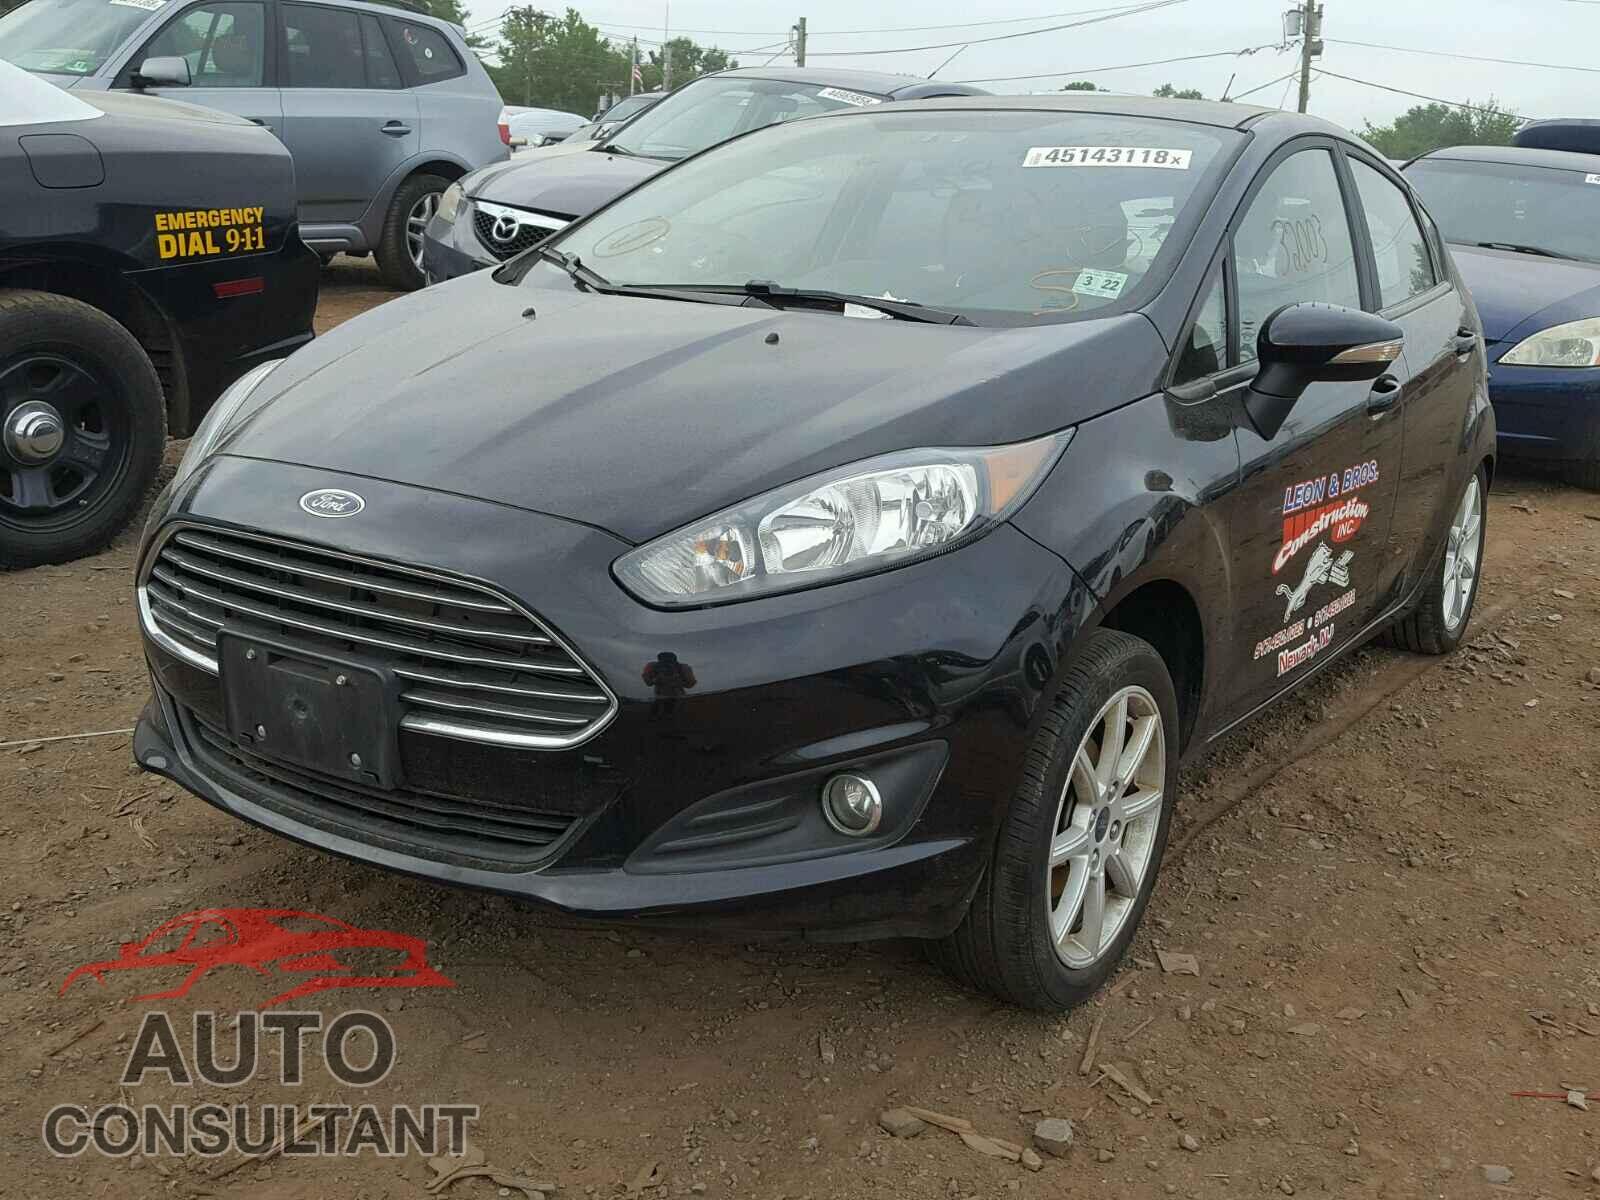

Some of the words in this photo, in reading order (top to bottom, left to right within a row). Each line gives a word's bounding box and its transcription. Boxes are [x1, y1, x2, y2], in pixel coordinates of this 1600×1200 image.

[155, 206, 264, 231] EMERGENCY
[158, 231, 220, 259] DIAL
[1082, 275, 1093, 286] 3
[1101, 279, 1120, 291] 22
[311, 493, 351, 512] Ford
[1283, 476, 1327, 515] LEON
[1328, 473, 1339, 498] &
[1272, 497, 1370, 573] Construction
[1319, 623, 1335, 649] NJ
